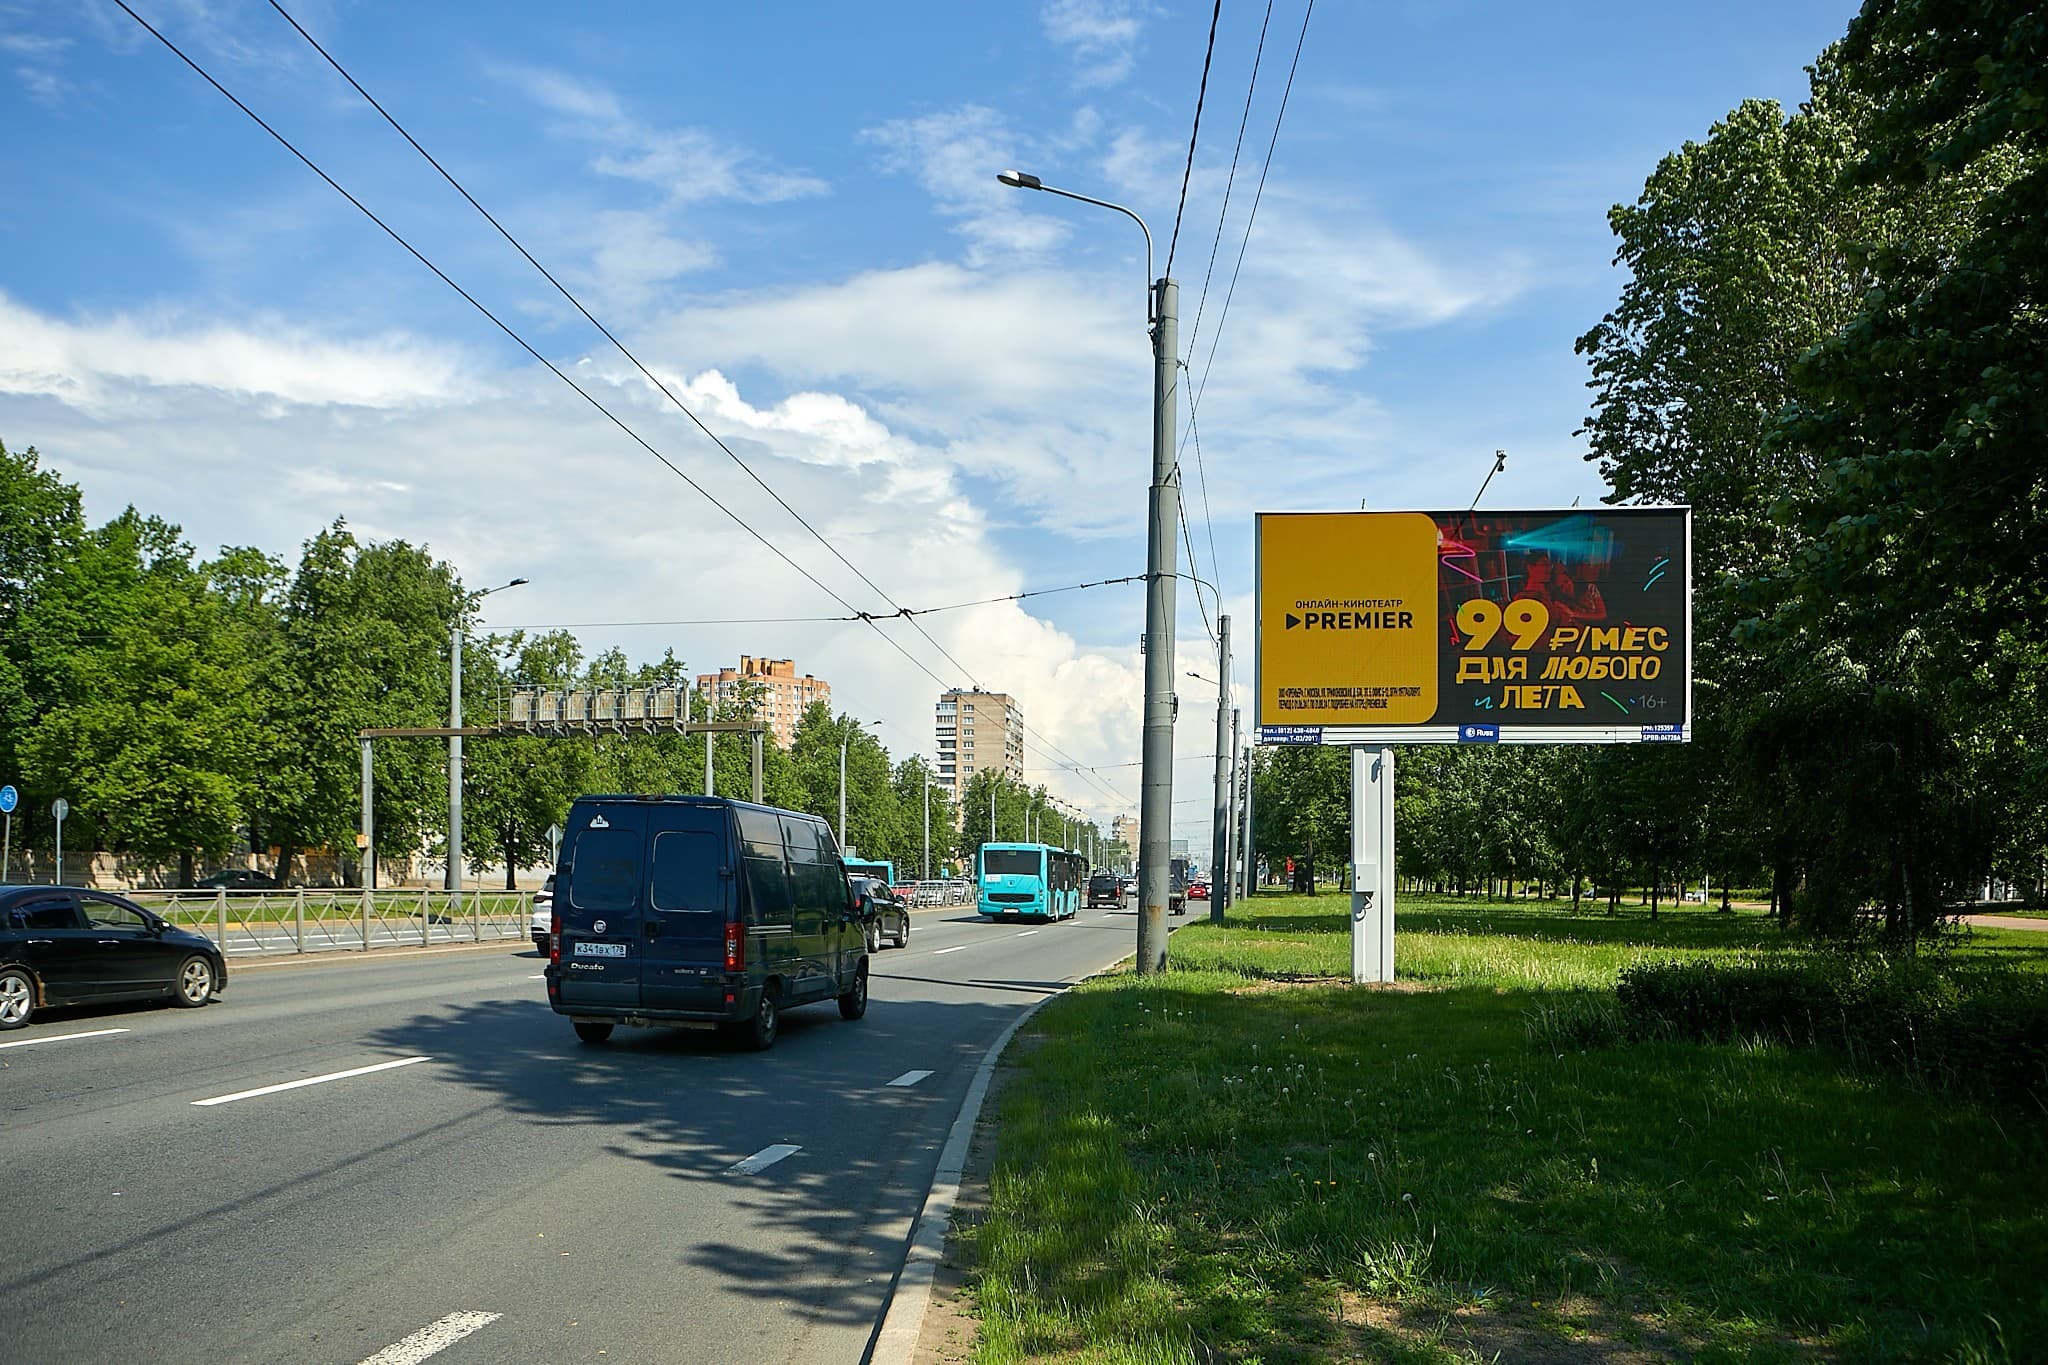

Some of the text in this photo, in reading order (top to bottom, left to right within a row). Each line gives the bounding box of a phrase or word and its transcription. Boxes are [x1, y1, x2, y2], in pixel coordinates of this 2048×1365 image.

[1295, 599, 1403, 609] ОНЛАЙН-КИНОТЕАТР
[1304, 611, 1413, 630] PREMIER
[1456, 598, 1549, 651] 99
[1456, 655, 1662, 684] ДЛЯ ЛЮБОГО
[1500, 685, 1586, 709] ЛЕТА
[1639, 695, 1668, 709] 16+
[1476, 729, 1494, 737] Russ
[570, 962, 605, 971] Ducato
